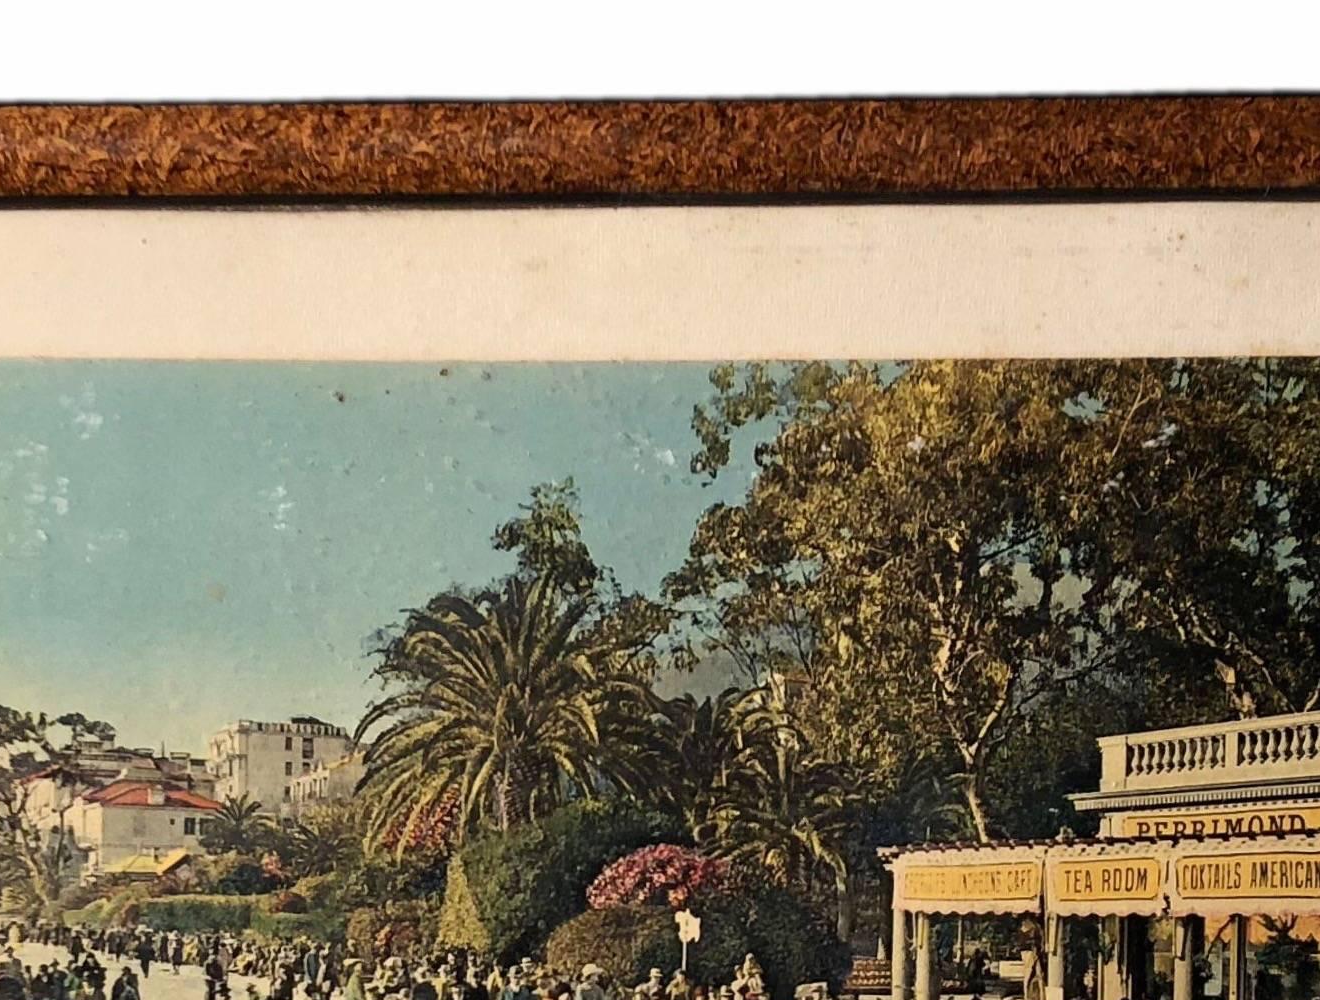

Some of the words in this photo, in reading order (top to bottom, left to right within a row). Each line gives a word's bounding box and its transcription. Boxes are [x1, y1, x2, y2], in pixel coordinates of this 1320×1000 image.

[1064, 869, 1093, 893] TEA
[1101, 867, 1148, 892] ROOM
[1182, 861, 1242, 890] COKTAILS
